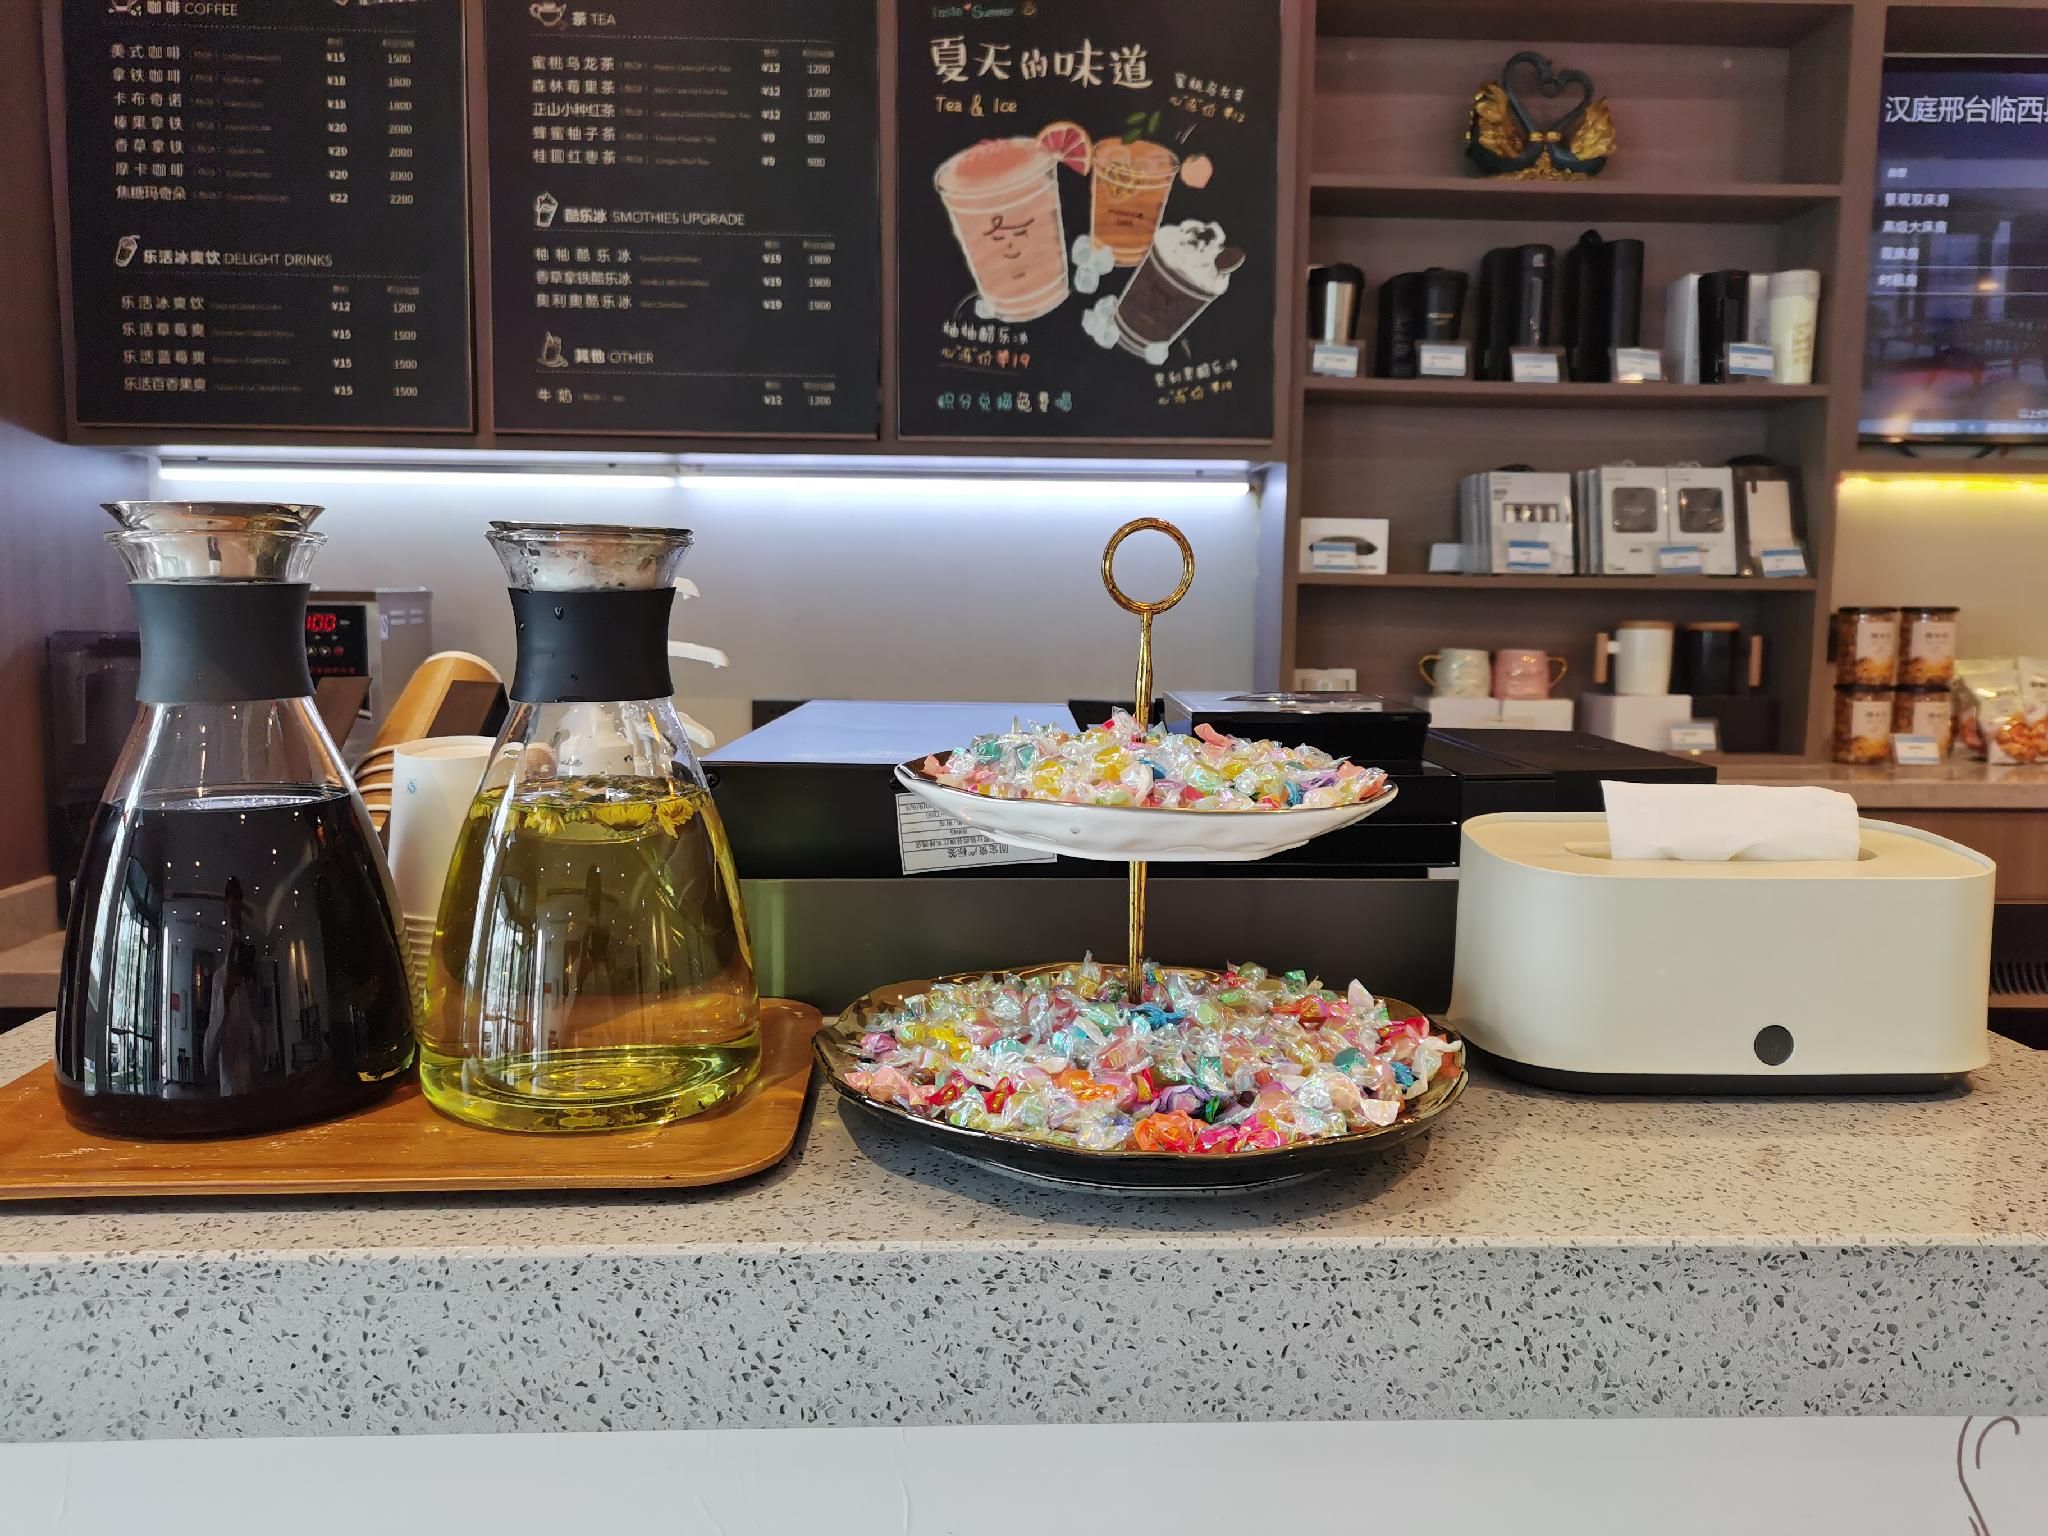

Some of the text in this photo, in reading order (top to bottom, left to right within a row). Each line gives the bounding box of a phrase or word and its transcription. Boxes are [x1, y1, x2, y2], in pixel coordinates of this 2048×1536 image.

[147, 0, 238, 16] 咖啡 COFFEE
[572, 12, 616, 26] 茶 TEA
[112, 43, 180, 60] 美式咖啡
[532, 55, 614, 71] 蜜桃乌龙茶
[930, 35, 1153, 89] 夏天的味道
[113, 68, 180, 84] 拿铁咖啡
[114, 92, 181, 107] 卡布奇诺
[936, 94, 1017, 117] Tea & Ice
[533, 103, 615, 118] 正山小种红茶
[1885, 96, 2048, 124] 汉庭邢台临西
[533, 126, 615, 141] 蜂蜜柚子茶
[115, 138, 184, 154] 香草拿铁
[116, 162, 183, 177] 摩卡咖啡
[565, 208, 607, 223] 酷乐冰
[683, 212, 744, 225] UPGRADE
[144, 250, 332, 267] 乐活冰爽饮 DELIGHT DRINKS
[536, 270, 632, 286] 香草拿铁酷乐冰
[122, 296, 204, 310] 乐活冰爽饮
[537, 293, 632, 309] 奥利奥酷乐冰
[610, 351, 653, 364] OTHER
[538, 388, 572, 403] 牛奶
[948, 844, 1008, 858] 固定资产标签
